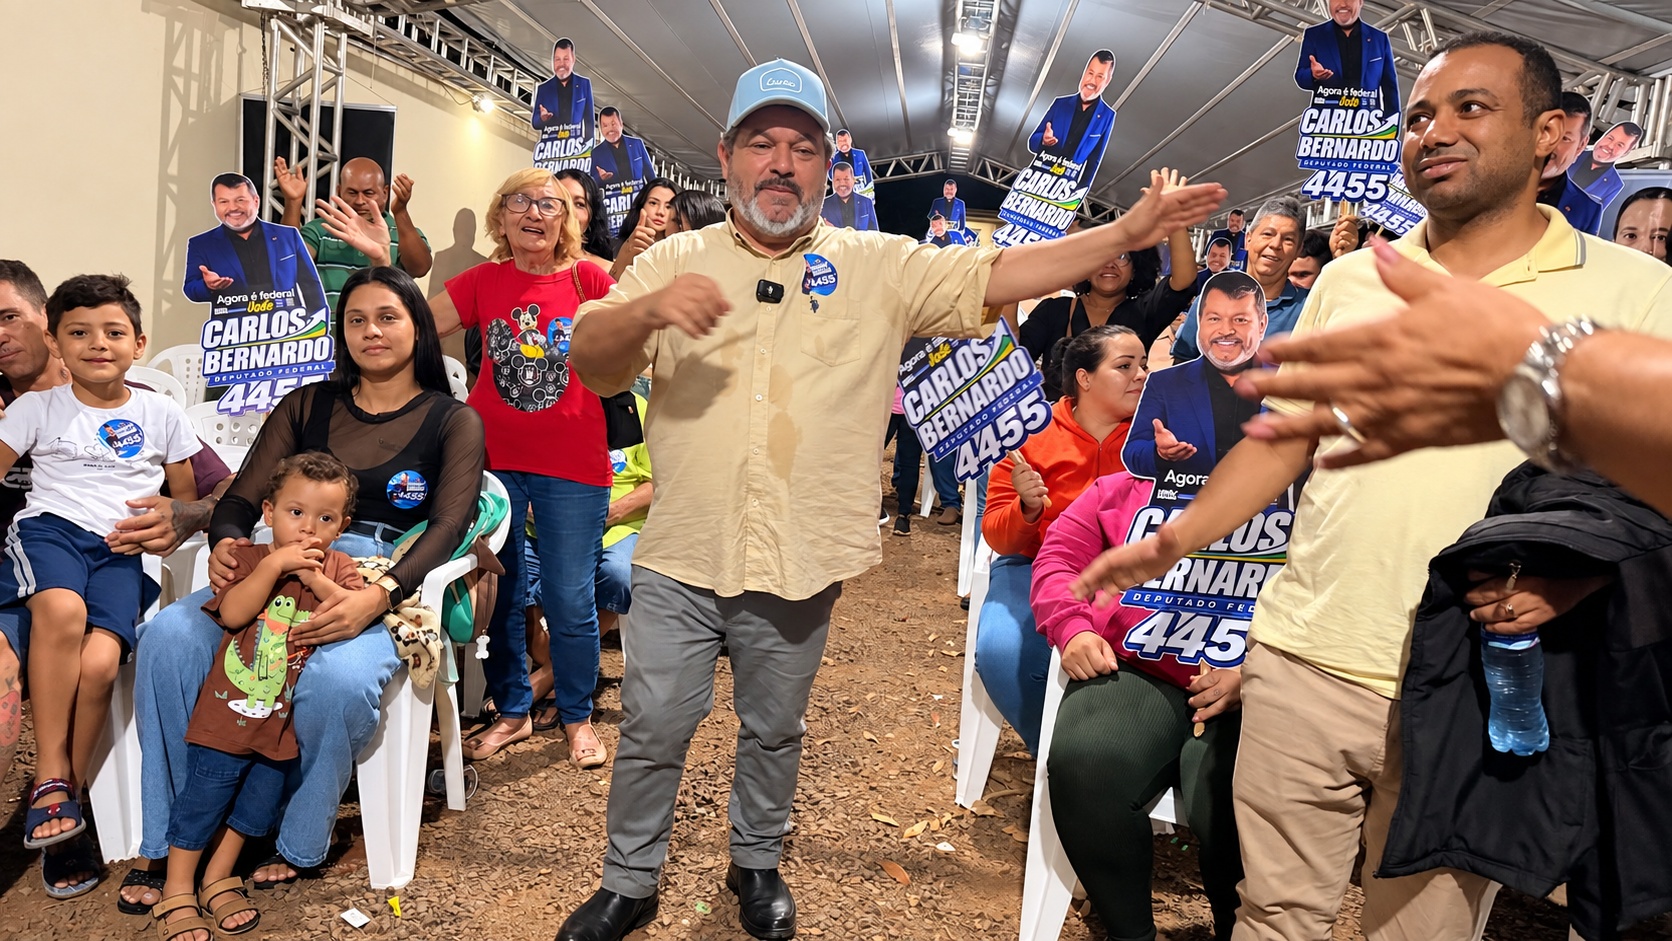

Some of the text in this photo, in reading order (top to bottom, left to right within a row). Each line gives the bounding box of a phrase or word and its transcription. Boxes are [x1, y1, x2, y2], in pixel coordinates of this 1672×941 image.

[1317, 85, 1342, 97] Agora
[1301, 108, 1384, 134] CARLOS
[535, 137, 584, 161] CARLOS
[1298, 136, 1399, 161] BERNARDO
[1014, 168, 1078, 200] CARLOS
[1303, 170, 1389, 200] 4455
[1003, 191, 1073, 231] BERNARDO
[217, 287, 295, 306] Agora é federal
[203, 308, 307, 349] CARLOS
[204, 336, 330, 375] BERNARDO
[898, 351, 926, 376] Agora
[903, 338, 992, 425] CARLOS
[918, 348, 1030, 451] BERNARDO
[957, 390, 1048, 478] 4455
[1133, 593, 1217, 609] DEPUTADO
